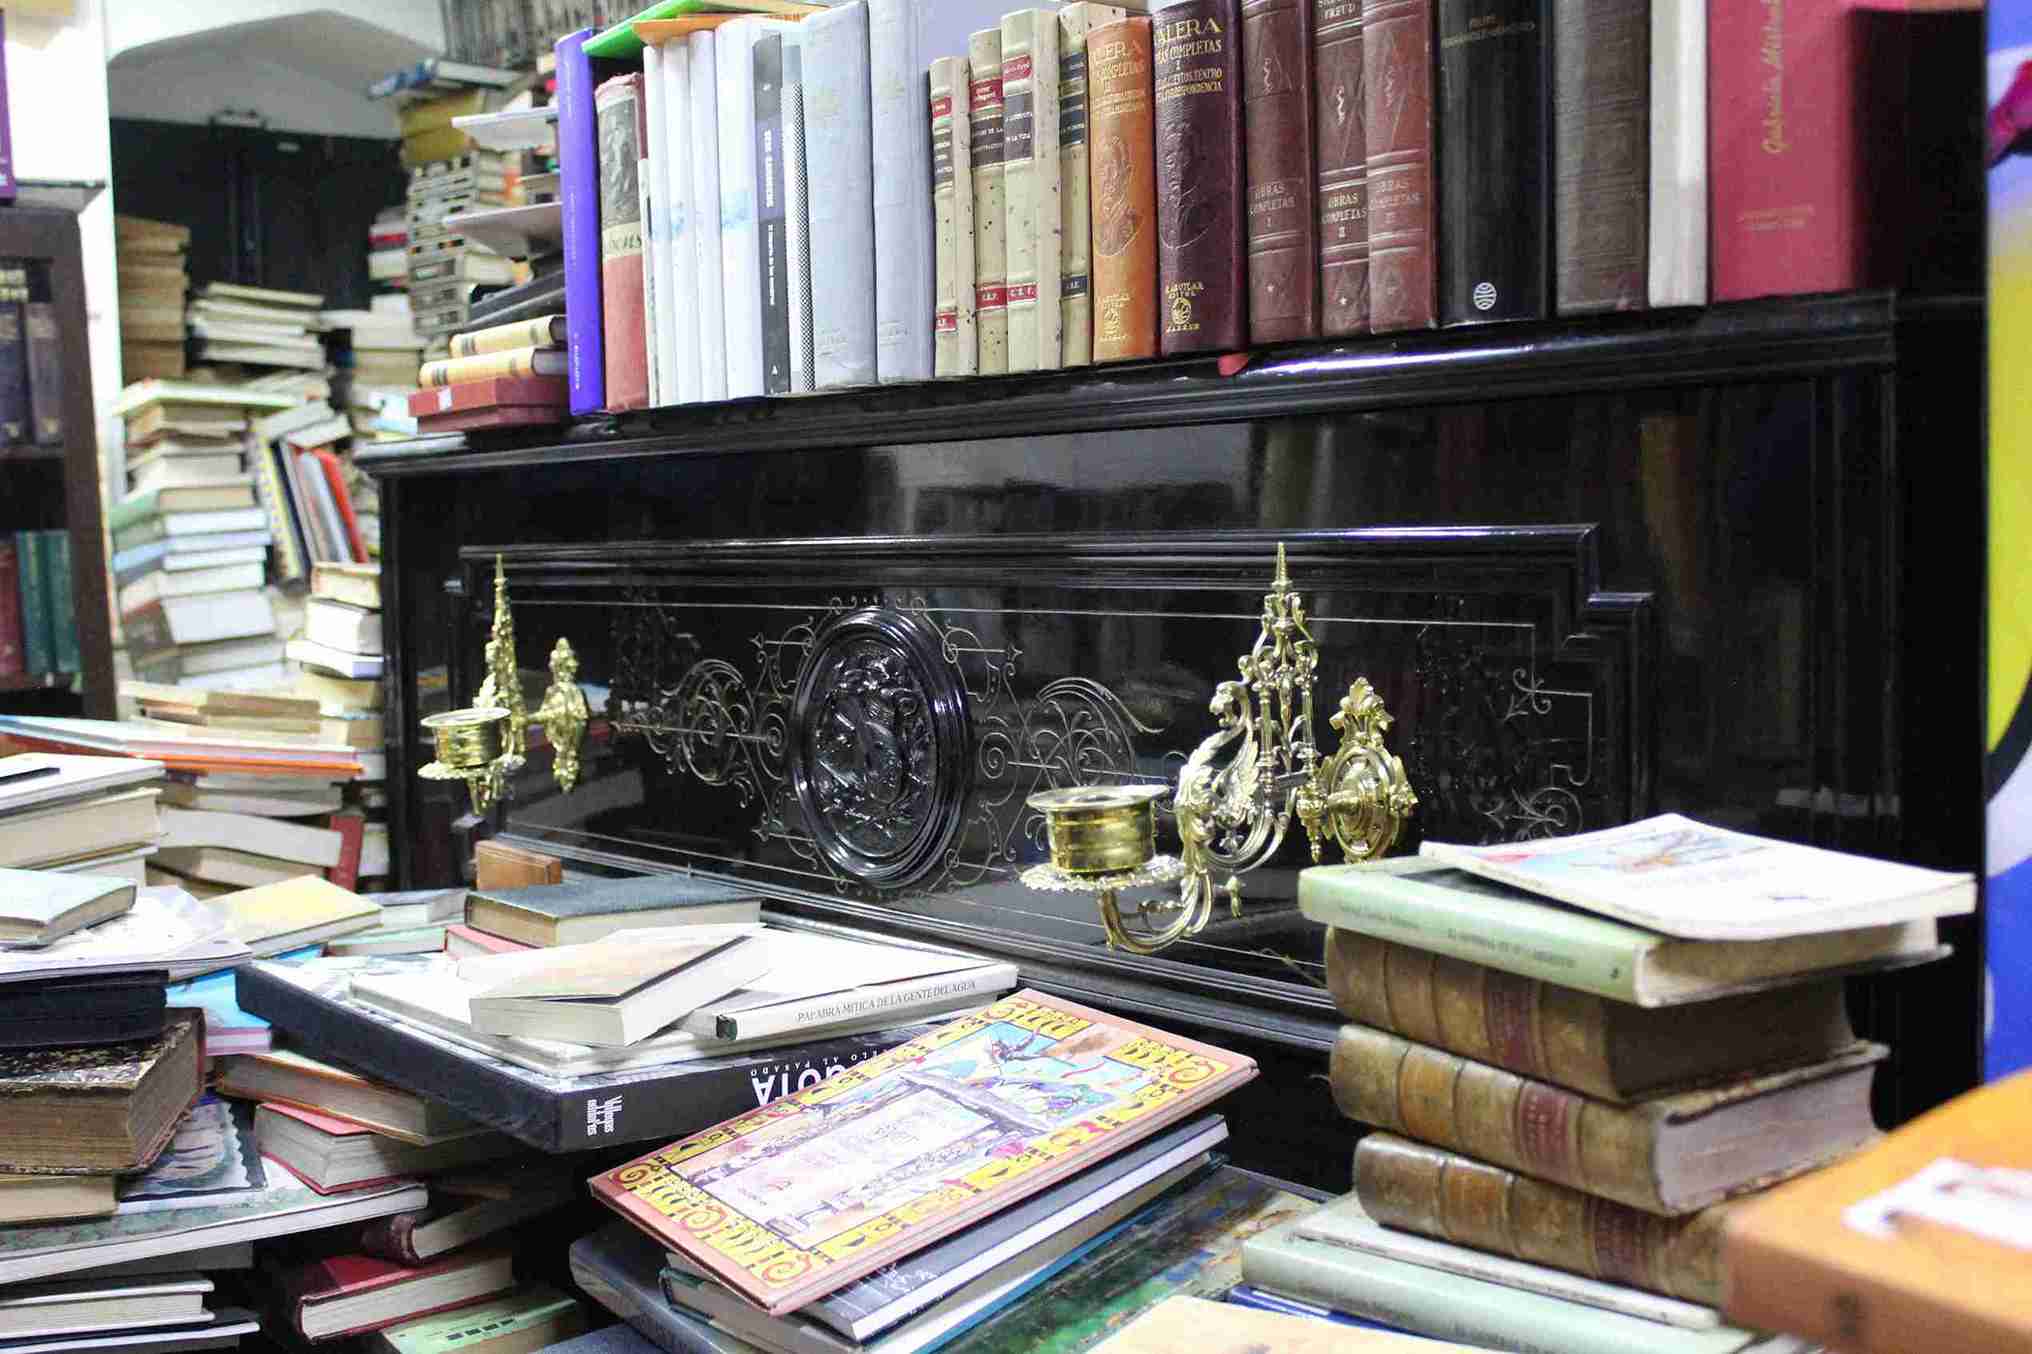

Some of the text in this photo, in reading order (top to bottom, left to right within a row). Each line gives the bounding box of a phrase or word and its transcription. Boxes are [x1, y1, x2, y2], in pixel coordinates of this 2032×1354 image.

[1156, 17, 1223, 42] ALERA
[1327, 192, 1359, 209] OBRAS
[1321, 206, 1368, 225] COMPLETAS
[797, 980, 977, 1022] PALABRA MITICA DE LA GENTE DEL AGUA
